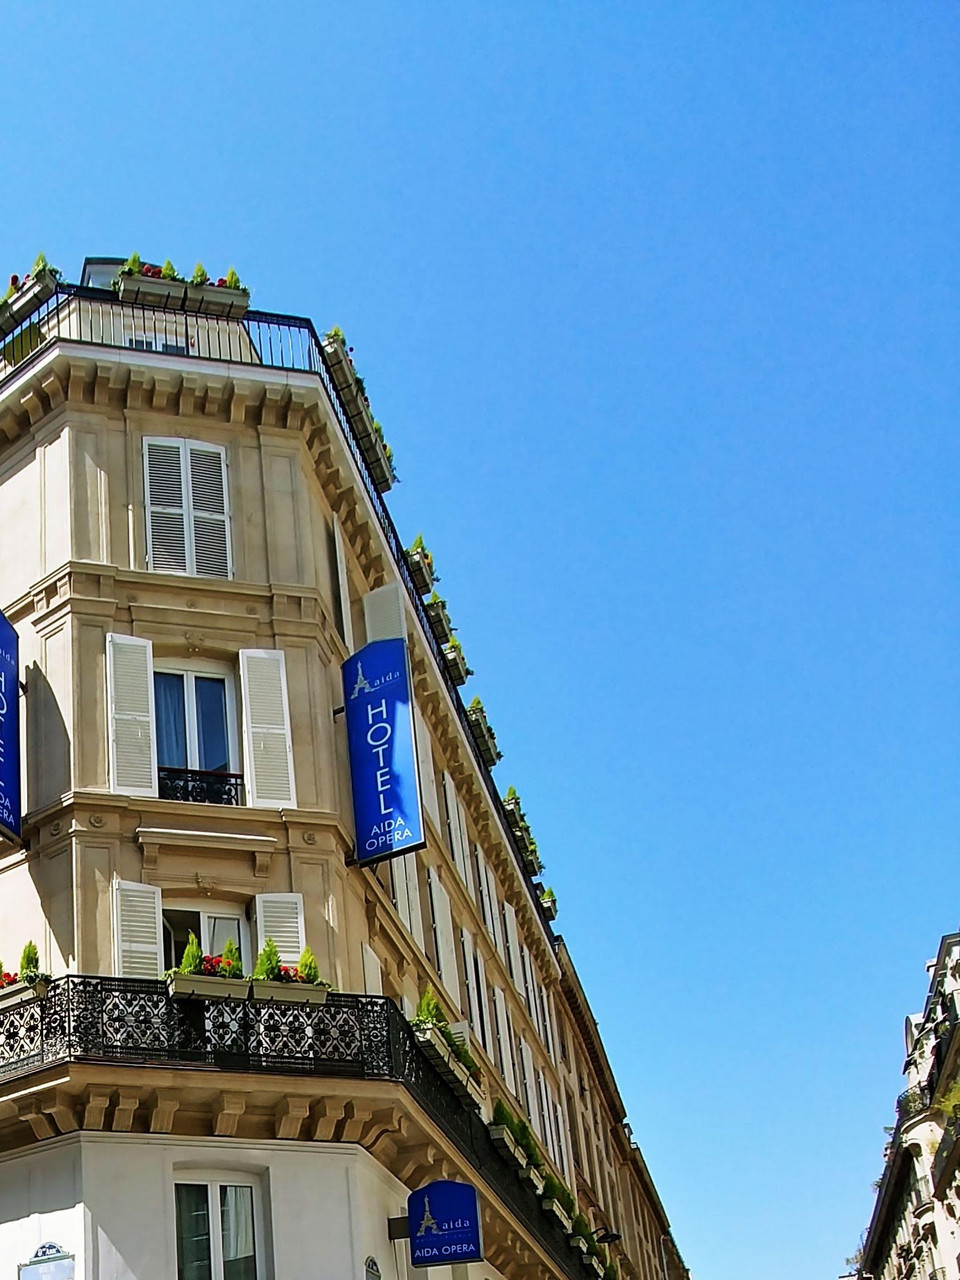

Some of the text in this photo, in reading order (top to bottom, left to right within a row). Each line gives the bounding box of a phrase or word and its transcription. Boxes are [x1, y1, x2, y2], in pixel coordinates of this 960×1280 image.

[374, 672, 401, 686] aida
[366, 698, 394, 815] HOTEL
[370, 816, 406, 837] AIDA
[365, 828, 413, 851] OPERA
[442, 1218, 470, 1230] aida
[414, 1243, 476, 1258] AIDA OPERA
